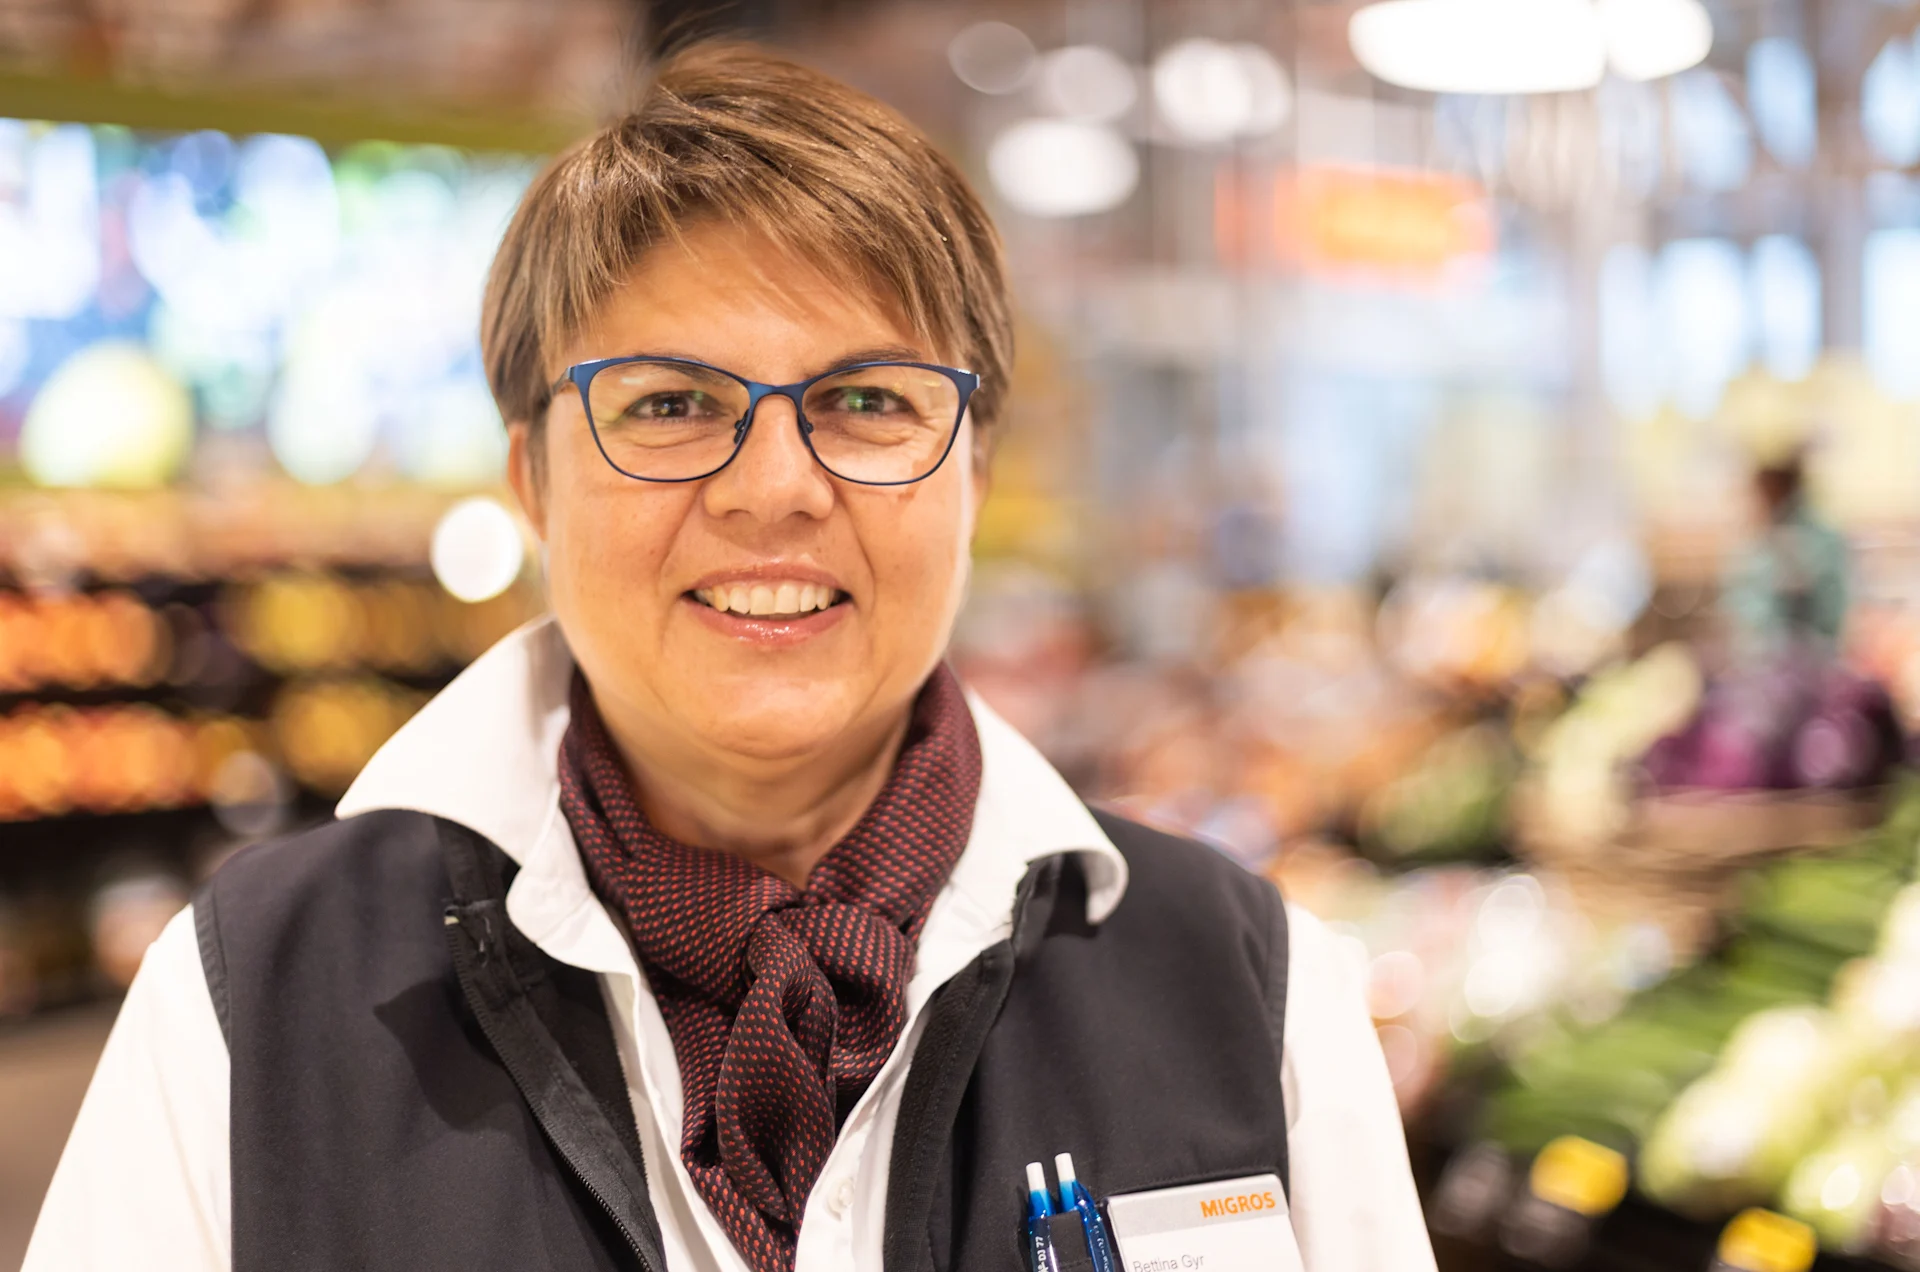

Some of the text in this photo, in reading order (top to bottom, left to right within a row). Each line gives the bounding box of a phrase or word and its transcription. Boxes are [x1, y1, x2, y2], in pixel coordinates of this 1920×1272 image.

[1200, 1191, 1276, 1218] MIGROS
[1132, 1254, 1204, 1272] Bettina Gyr
